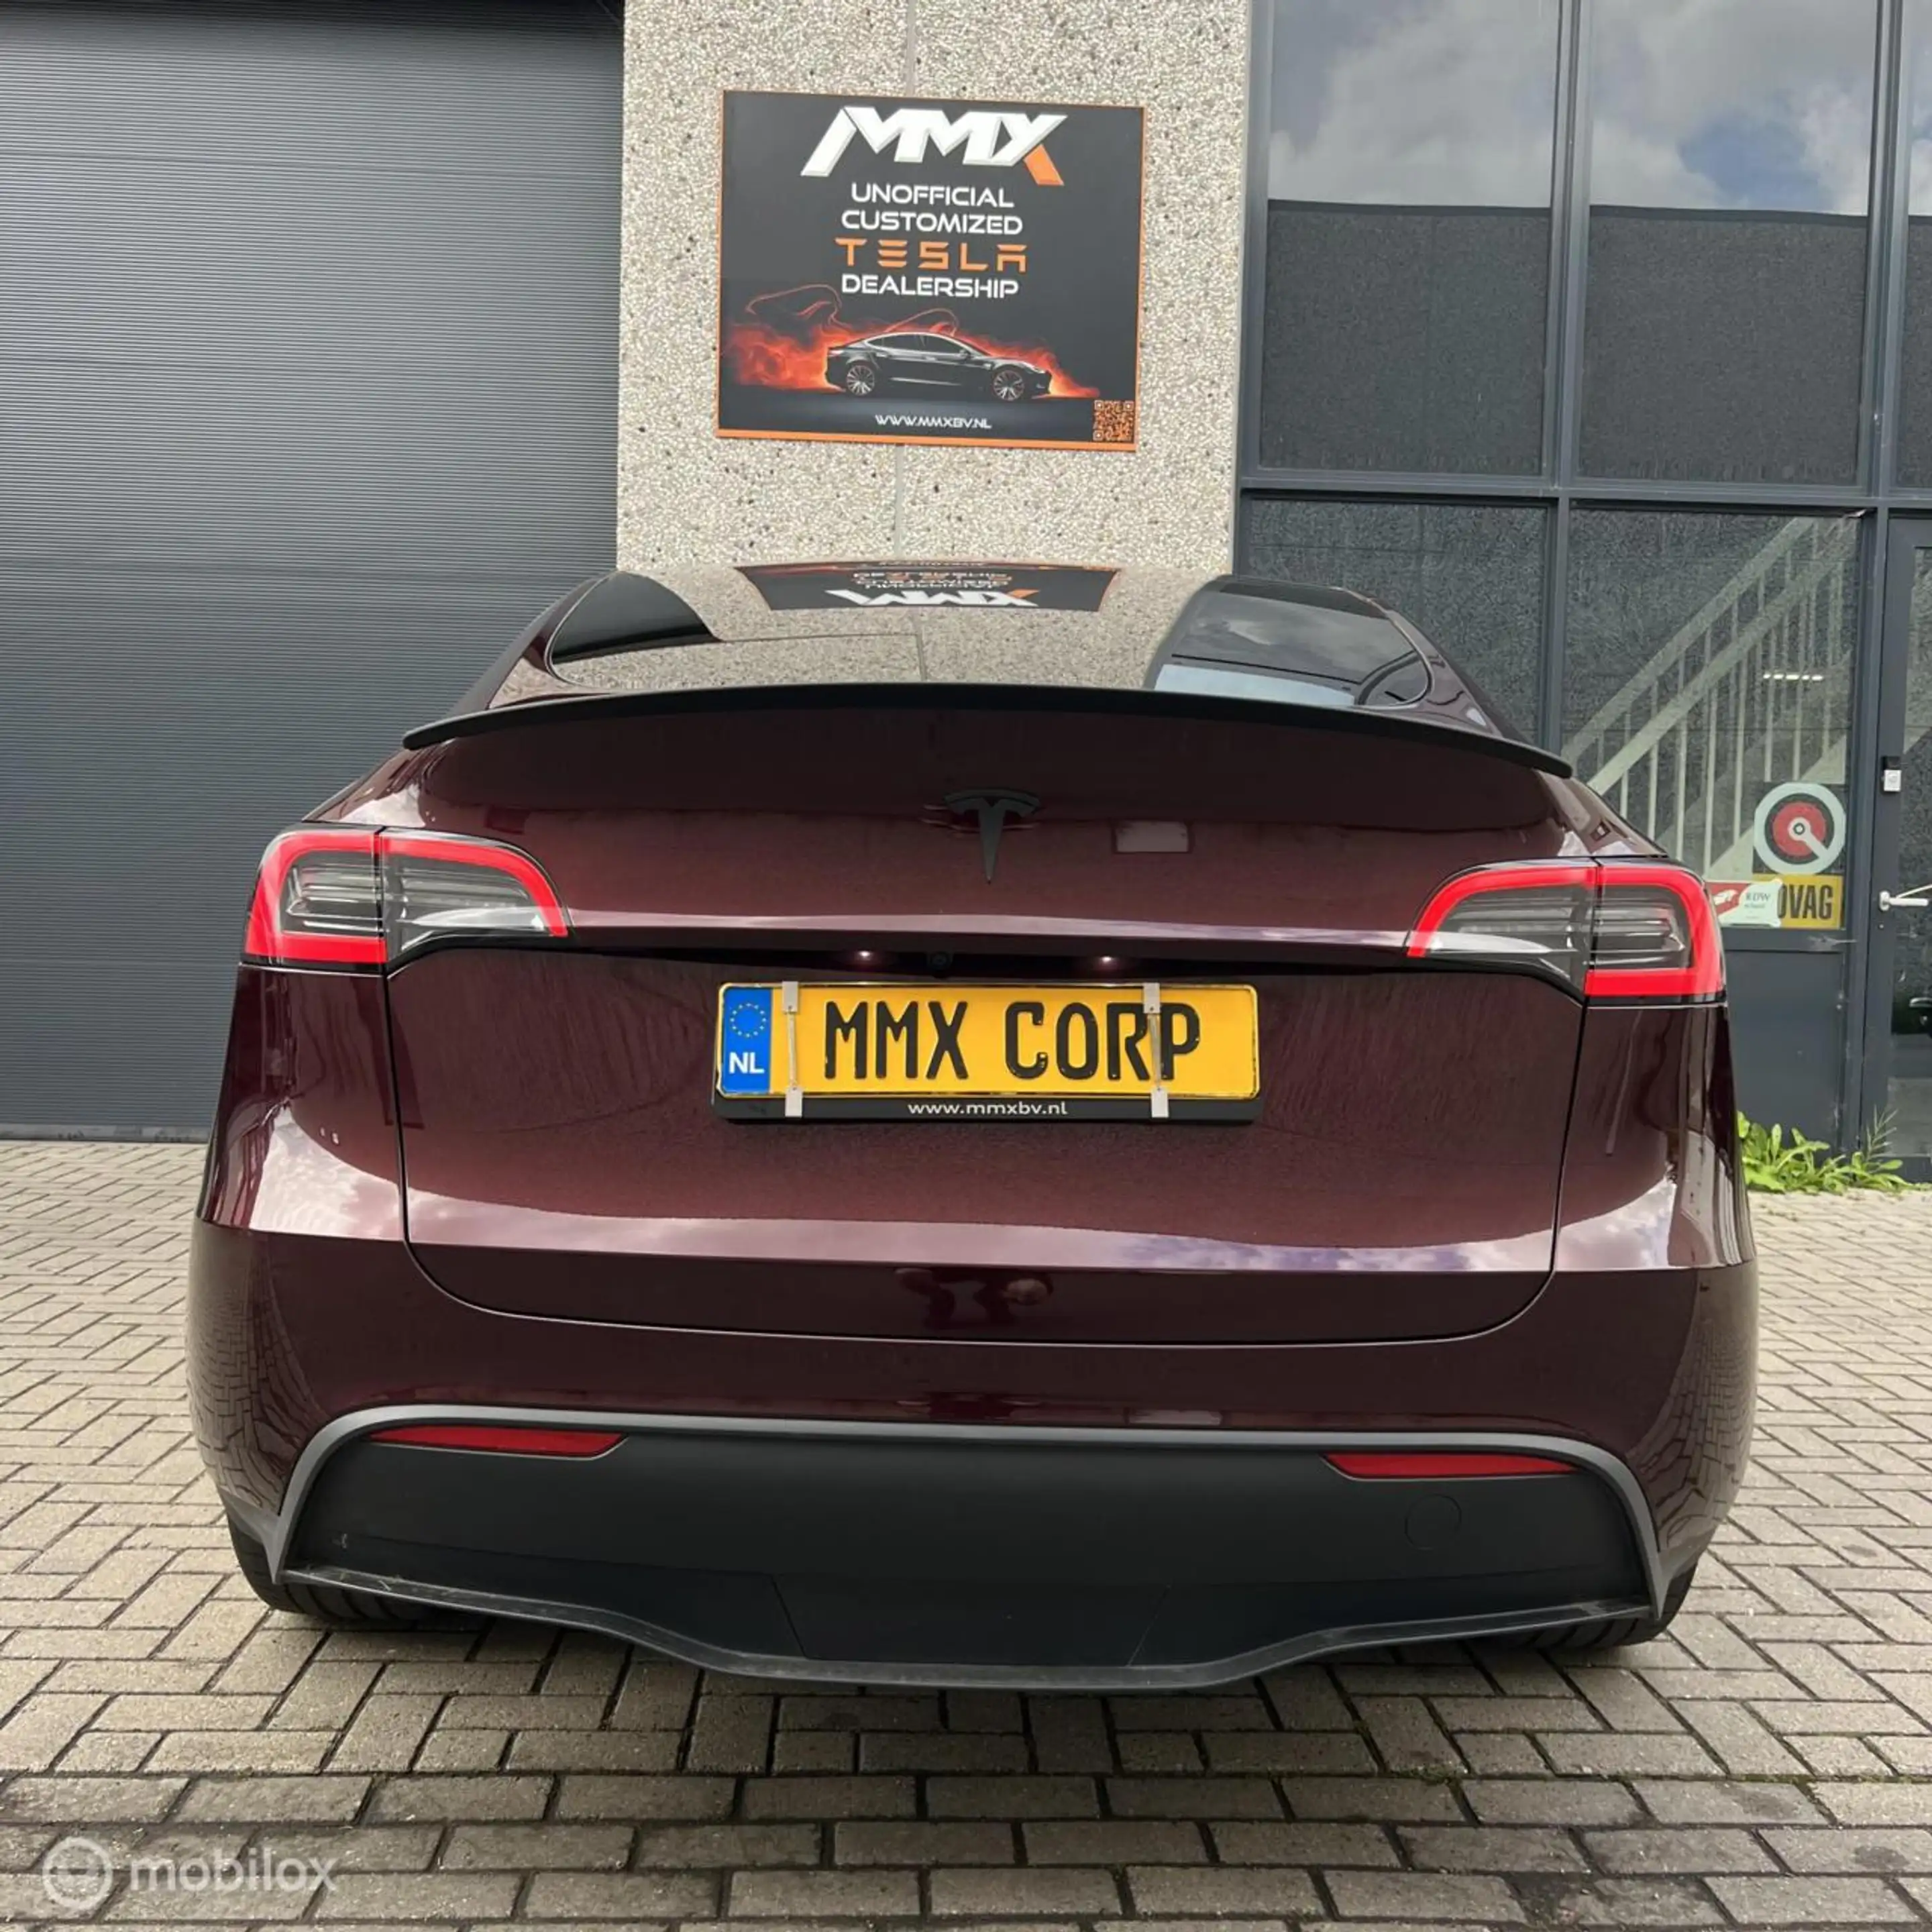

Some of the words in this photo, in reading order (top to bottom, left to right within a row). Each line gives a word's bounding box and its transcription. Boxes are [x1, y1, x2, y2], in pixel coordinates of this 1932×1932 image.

[800, 105, 1068, 186] MMX
[851, 182, 1014, 208] UNOFFICIAL
[841, 209, 1023, 235] CUSTOMIZED
[835, 237, 1028, 272] TESLA
[841, 273, 1019, 299] DEALERSHIP
[875, 414, 992, 429] WWW.MMXBV.NL
[1777, 884, 1833, 919] OVAG
[824, 1000, 969, 1079] MMX
[1006, 1002, 1201, 1081] CORP
[729, 1051, 765, 1074] NL
[908, 1100, 1068, 1117] www.mmxbv.nl
